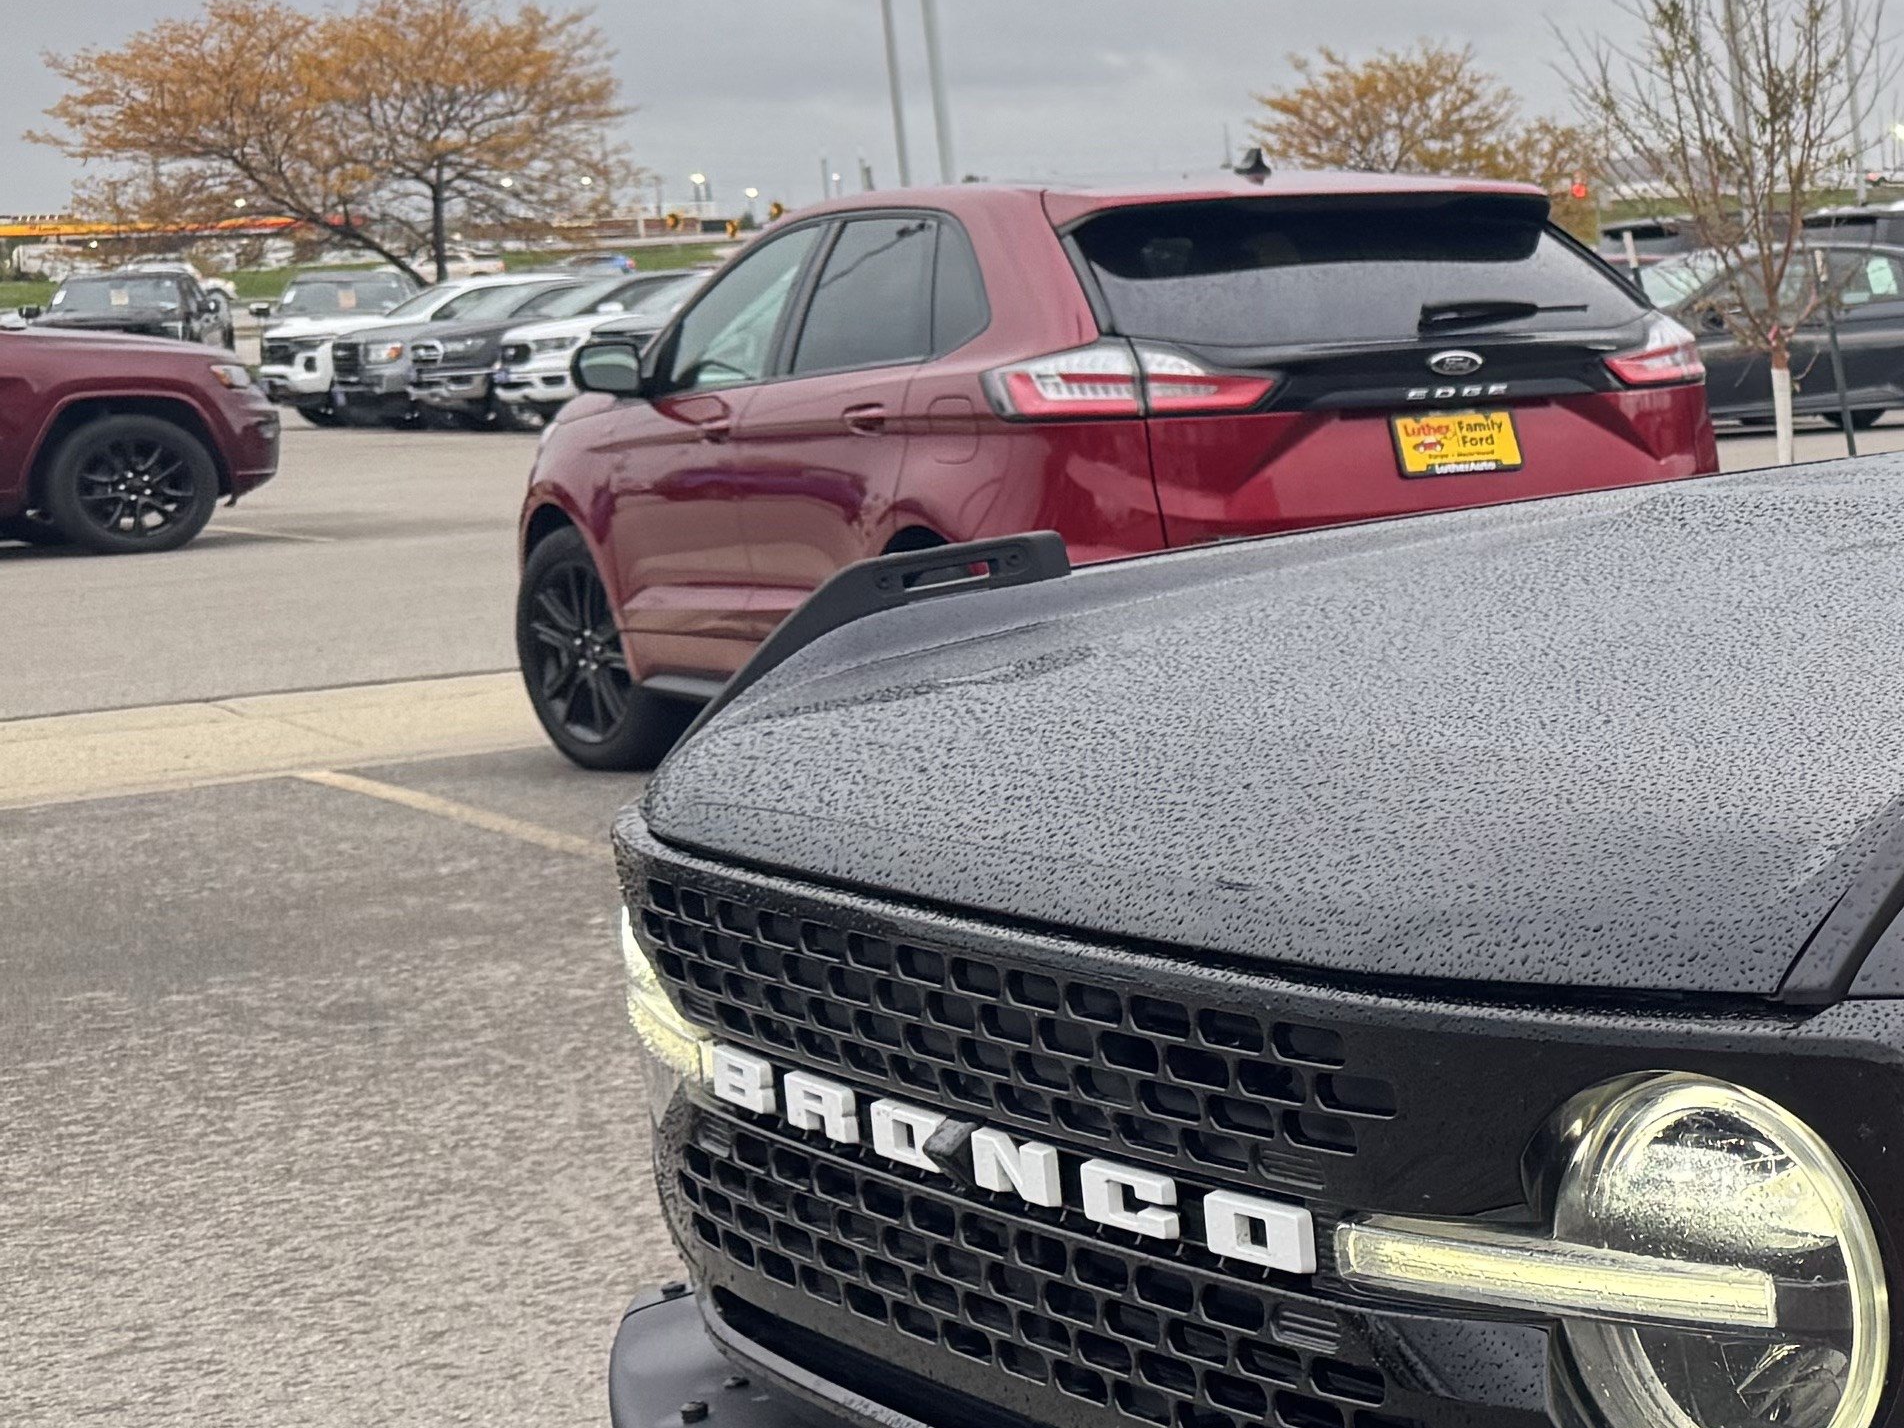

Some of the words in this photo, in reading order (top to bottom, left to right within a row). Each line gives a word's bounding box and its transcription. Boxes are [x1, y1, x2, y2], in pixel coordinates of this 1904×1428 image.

[1406, 383, 1508, 400] EDGE
[1404, 422, 1450, 438] Luther
[1457, 417, 1502, 434] Family
[1461, 434, 1495, 448] Ford
[712, 1043, 1317, 1275] BRONCO
